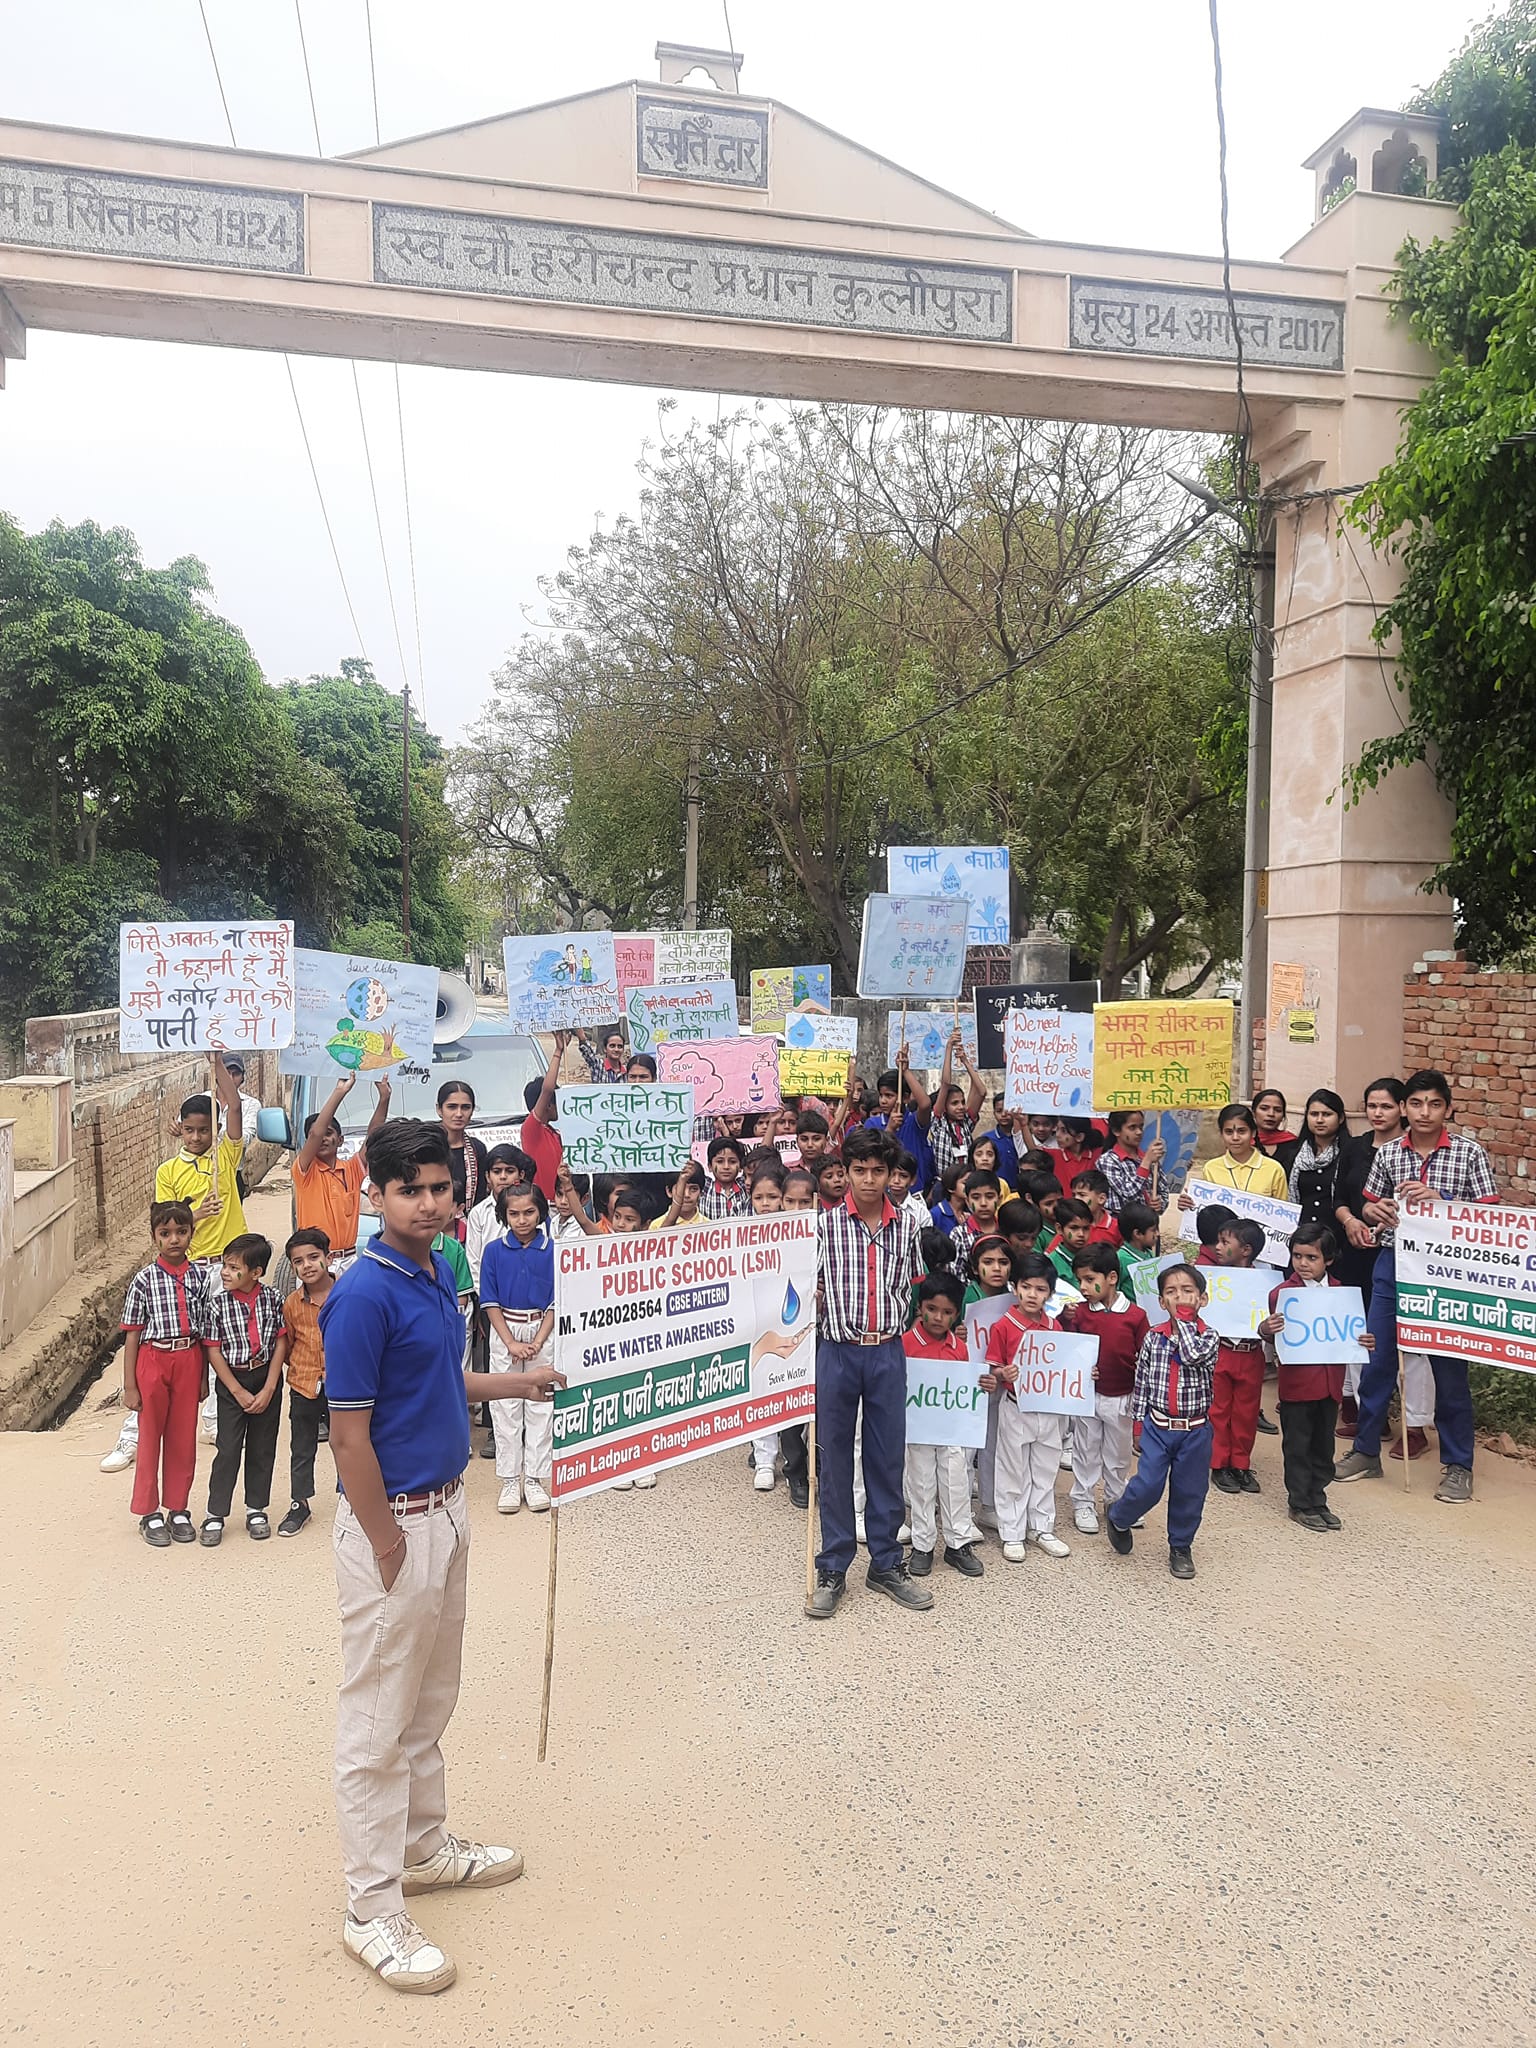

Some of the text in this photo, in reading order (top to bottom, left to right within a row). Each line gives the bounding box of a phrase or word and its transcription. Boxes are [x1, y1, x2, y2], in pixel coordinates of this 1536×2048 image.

[713, 134, 760, 181] द्वार
[33, 187, 54, 228] 5
[62, 177, 201, 243] सितम्बर
[211, 206, 293, 250] 1924
[527, 233, 699, 300] हरीचन्द
[709, 259, 818, 306] प्रधान
[1078, 299, 1139, 347] मृत्यु
[1145, 304, 1180, 340] 24
[1279, 316, 1335, 352] 2017
[904, 847, 942, 875] पानी
[126, 926, 160, 954] जिसे
[222, 929, 248, 949] ना
[248, 923, 293, 950] समझे
[968, 916, 1009, 944] चाओ
[146, 952, 169, 978] वो
[173, 949, 239, 982] कहानी
[121, 981, 165, 1018] मुझे
[168, 978, 221, 1010] बर्बाद
[224, 988, 257, 1008] मत
[261, 981, 293, 1011] करो
[145, 1007, 200, 1049] पानी
[234, 1005, 266, 1047] मैं
[1013, 1012, 1037, 1032] We
[1037, 1014, 1061, 1032] need
[1201, 1016, 1228, 1031] का
[1010, 1035, 1037, 1056] your
[1105, 1033, 1147, 1060] पानी
[1008, 1054, 1040, 1076] hand
[1043, 1059, 1059, 1076] to
[1123, 1069, 1155, 1084] कम
[1159, 1061, 1190, 1084] करो
[562, 1085, 690, 1123] जल बचाने का
[1106, 1091, 1142, 1107] कम
[596, 1112, 688, 1146] करो जतन
[743, 1140, 799, 1156] AVE ATER
[1406, 1198, 1439, 1219] CH.
[560, 1217, 815, 1274] CH. LAKHPAT SINGH MEMORIAL
[1403, 1240, 1420, 1252] M.
[1425, 1243, 1521, 1267] 7428028564
[1452, 1226, 1529, 1250] PUBLIC
[602, 1248, 782, 1299] PUBLIC SCHOOL (LSM)
[1427, 1264, 1463, 1281] SAVE
[1466, 1271, 1517, 1290] WATER
[669, 1286, 728, 1312] CBSE PATTERN
[1398, 1288, 1438, 1317] बच्चों
[1438, 1298, 1469, 1322] द्वारा
[1472, 1298, 1509, 1328] पानी
[559, 1298, 663, 1337] M. 7428028564
[1281, 1297, 1366, 1347] Save
[583, 1317, 736, 1368] SAVE WATER AWARENESS
[1018, 1334, 1056, 1366] the
[1400, 1327, 1432, 1342] Main
[1436, 1332, 1493, 1353] Ladpura
[768, 1367, 808, 1386] Save Water
[1018, 1367, 1086, 1400] world
[553, 1354, 747, 1440] बच्चों द्वारा पानी बचाओ अभियान
[906, 1376, 986, 1412] water
[556, 1462, 588, 1487] Main
[590, 1445, 641, 1476] Ladpura
[651, 1421, 711, 1454] Ghanghola
[713, 1410, 744, 1437] Road,
[745, 1399, 785, 1424] Greater
[785, 1391, 816, 1413] Noida
